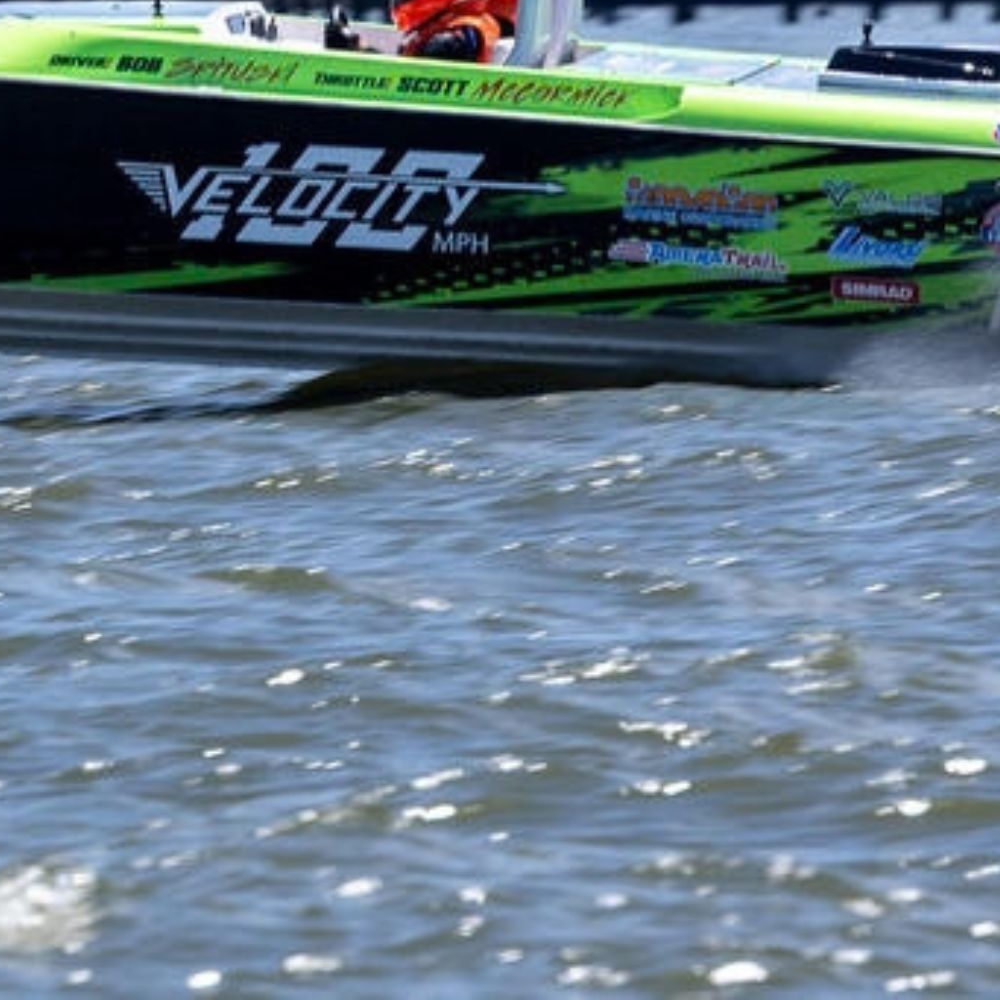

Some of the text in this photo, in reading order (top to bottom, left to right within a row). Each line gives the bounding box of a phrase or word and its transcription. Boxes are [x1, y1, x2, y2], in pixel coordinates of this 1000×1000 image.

[115, 55, 164, 73] BOB
[396, 76, 470, 96] SCOTT
[158, 163, 481, 228] VELOCITY
[431, 231, 490, 255] MPH
[841, 282, 914, 300] SIMRAD
